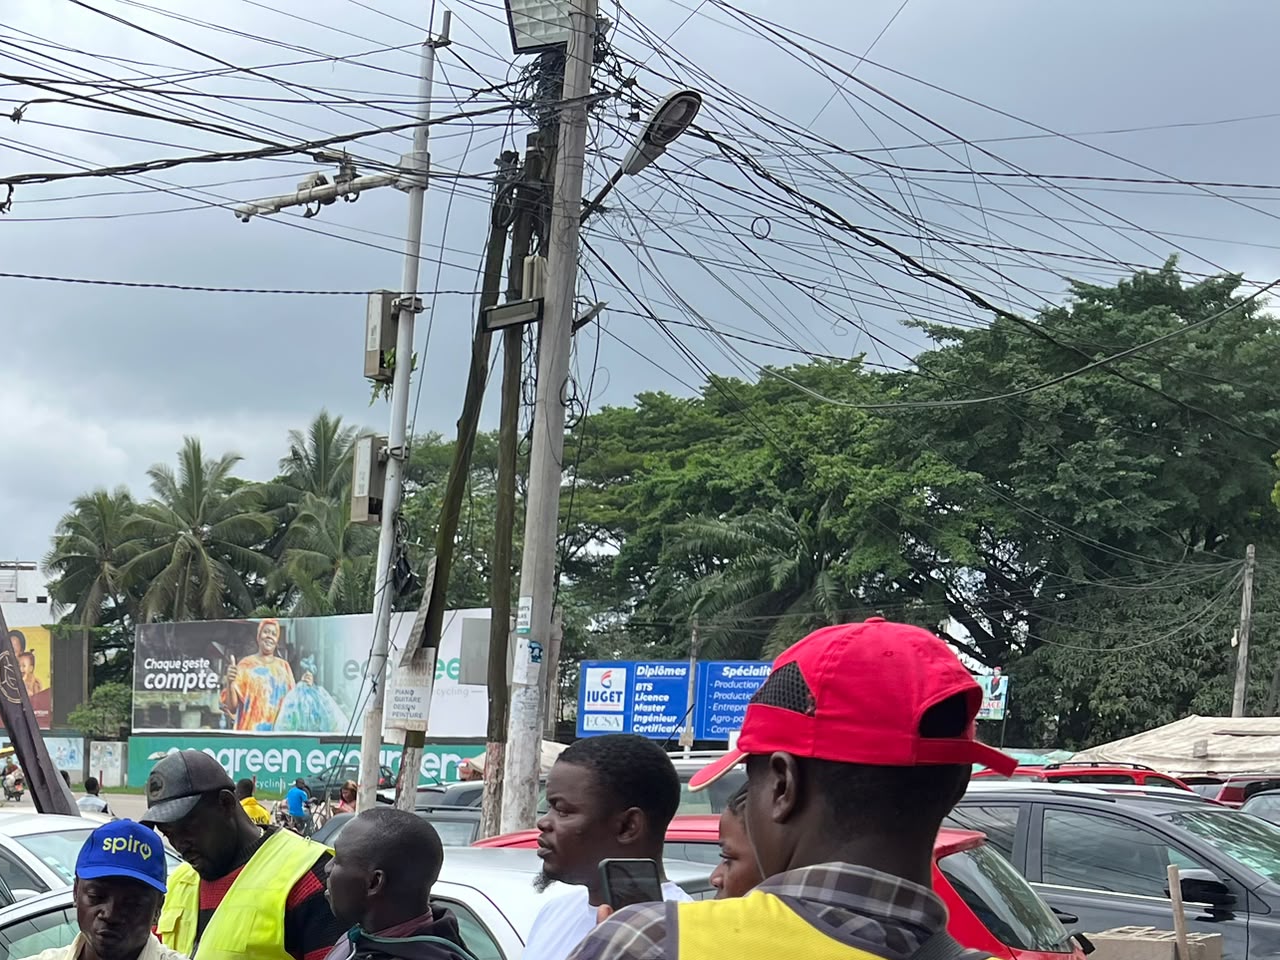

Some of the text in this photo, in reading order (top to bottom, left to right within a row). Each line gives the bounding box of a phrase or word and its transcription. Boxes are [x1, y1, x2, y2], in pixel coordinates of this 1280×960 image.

[144, 657, 210, 672] Chaque geste
[636, 664, 687, 677] Diplômes
[144, 671, 221, 694] compte.
[635, 683, 653, 691] BTS
[714, 680, 759, 689] Production
[587, 691, 623, 703] IUGET
[635, 693, 669, 702] Licence
[634, 704, 666, 713] Master
[586, 716, 621, 728] ECSA
[633, 714, 677, 724] Ingénieur
[102, 834, 152, 860] spiro
